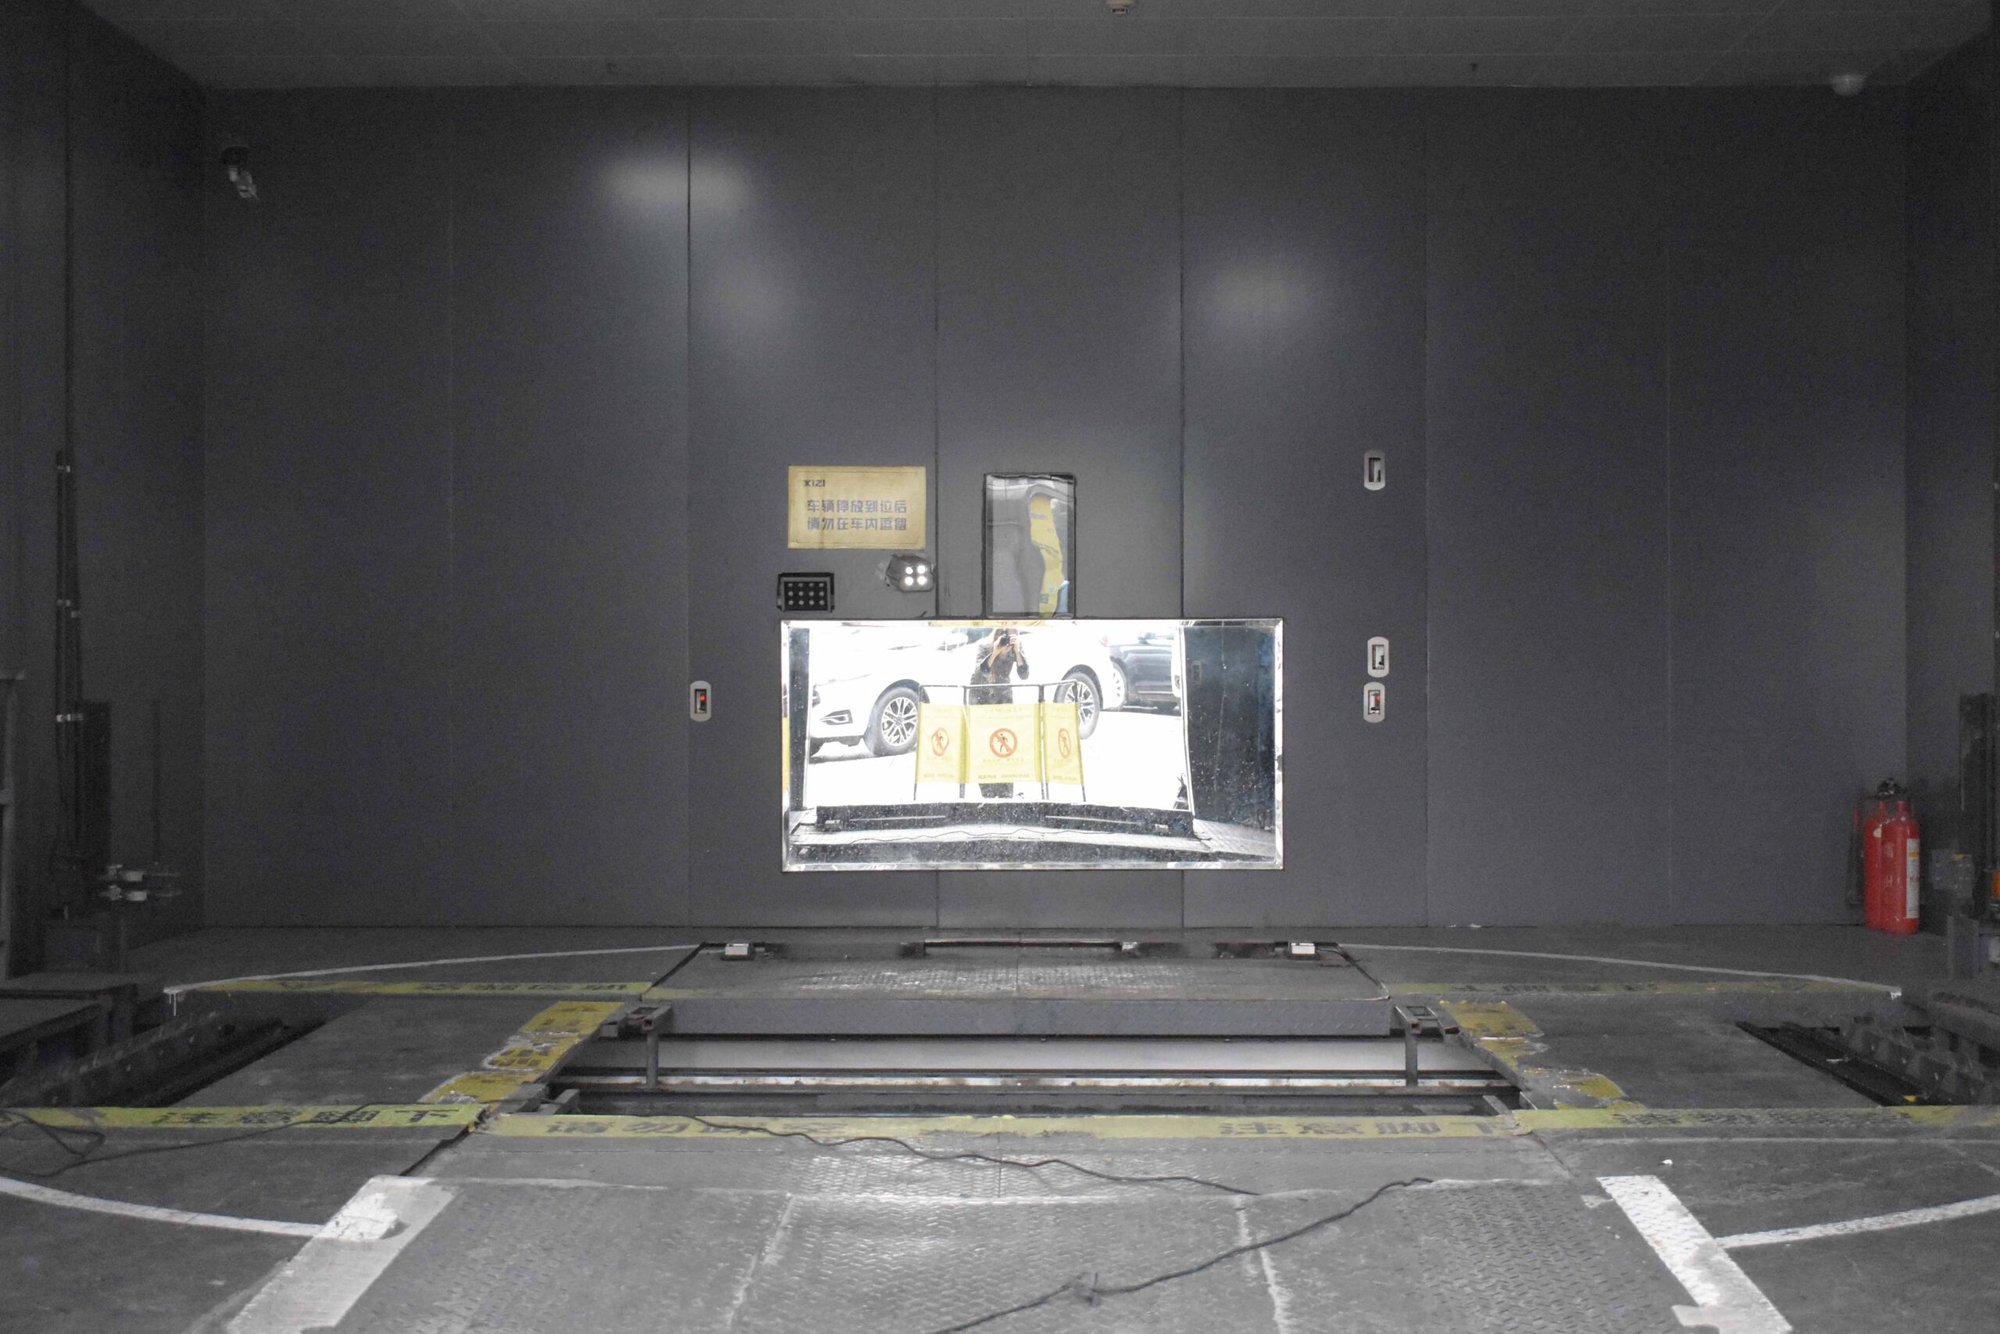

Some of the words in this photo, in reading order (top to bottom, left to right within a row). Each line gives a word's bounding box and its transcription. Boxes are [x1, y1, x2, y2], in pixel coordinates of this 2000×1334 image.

[807, 499, 908, 514] 车辆停放到位后
